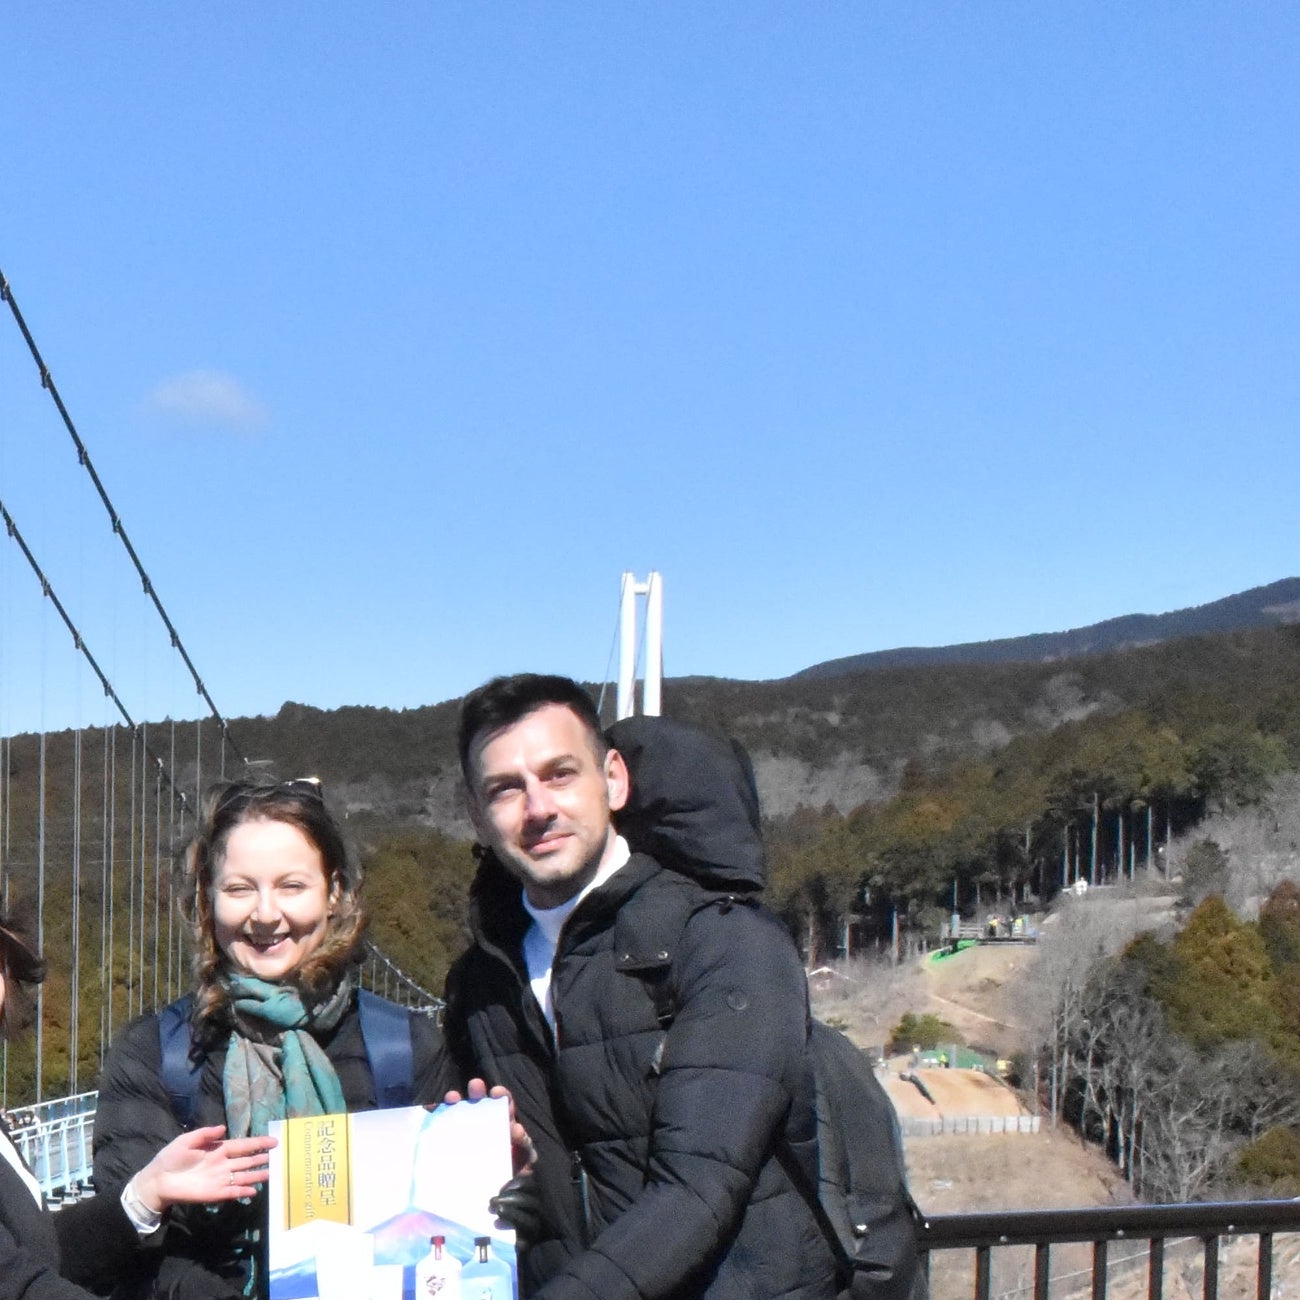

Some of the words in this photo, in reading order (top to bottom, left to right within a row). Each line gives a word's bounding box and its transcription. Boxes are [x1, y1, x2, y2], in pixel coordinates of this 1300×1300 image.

[317, 1120, 337, 1206] 記念品贈呈
